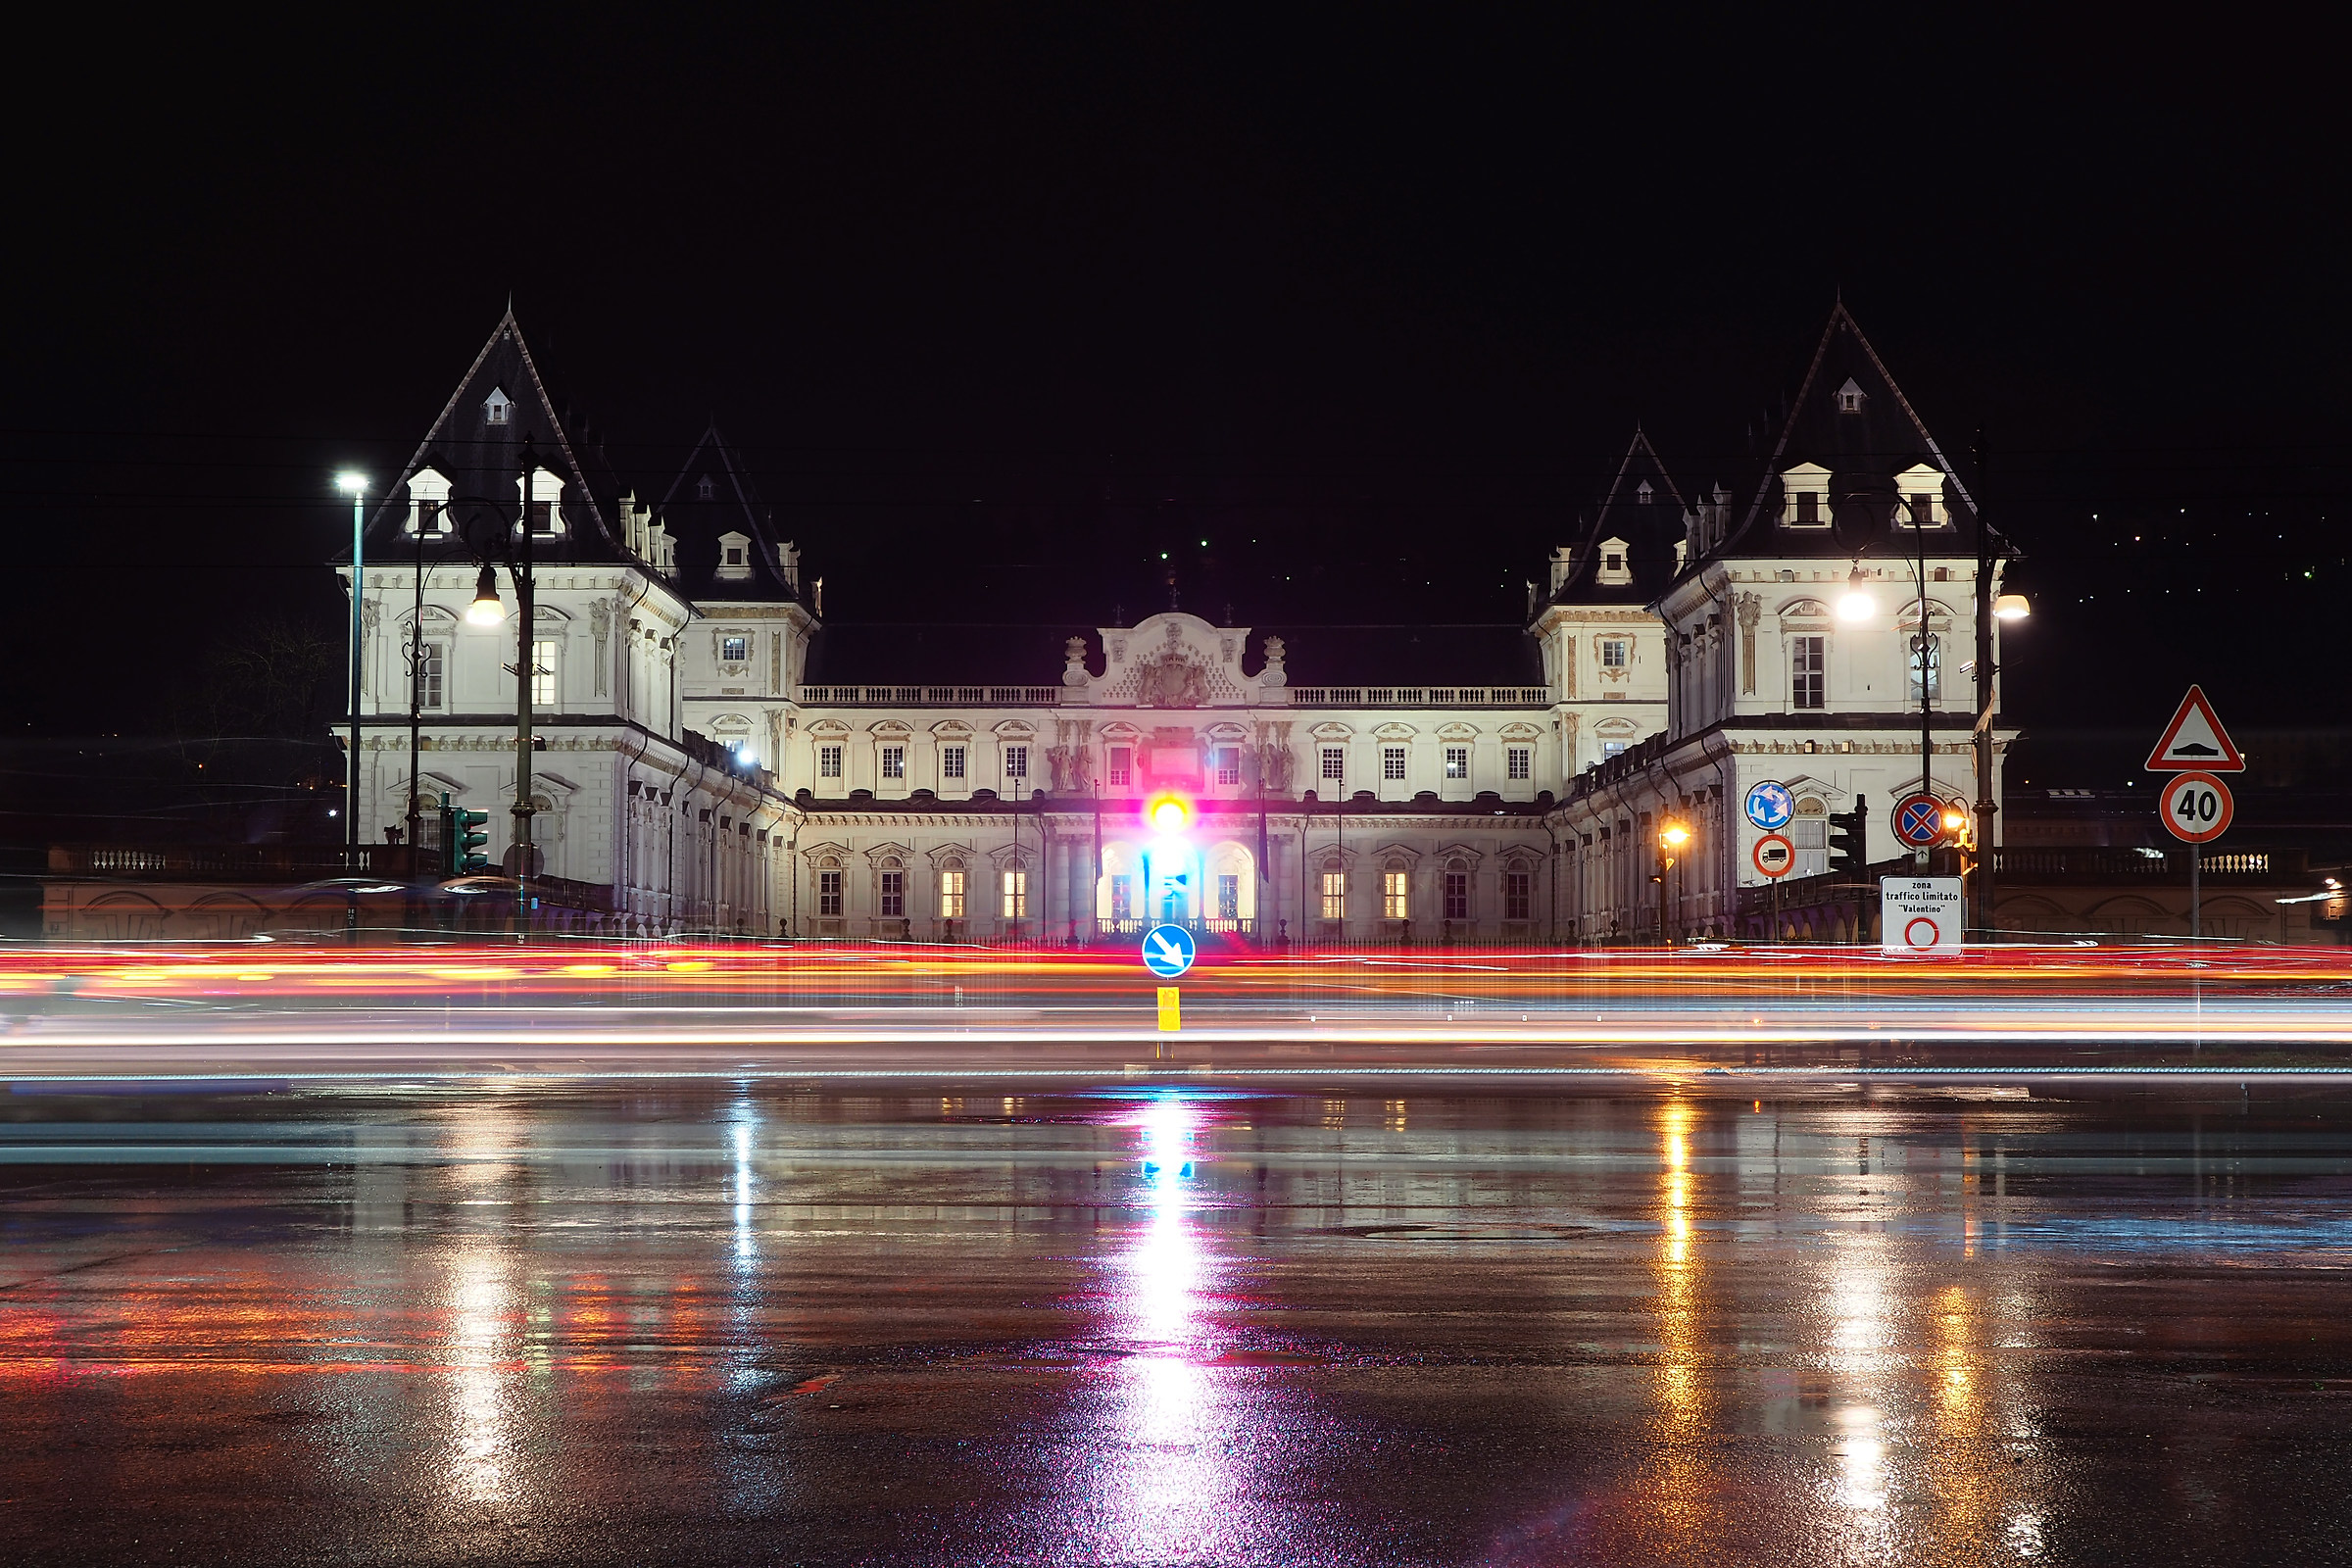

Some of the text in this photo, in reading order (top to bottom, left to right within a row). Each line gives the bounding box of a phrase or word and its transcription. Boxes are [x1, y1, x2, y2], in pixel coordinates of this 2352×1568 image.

[2178, 789, 2217, 821] 40
[1886, 892, 1958, 901] traffico limitato
[1898, 904, 1945, 912] "Valentino"
